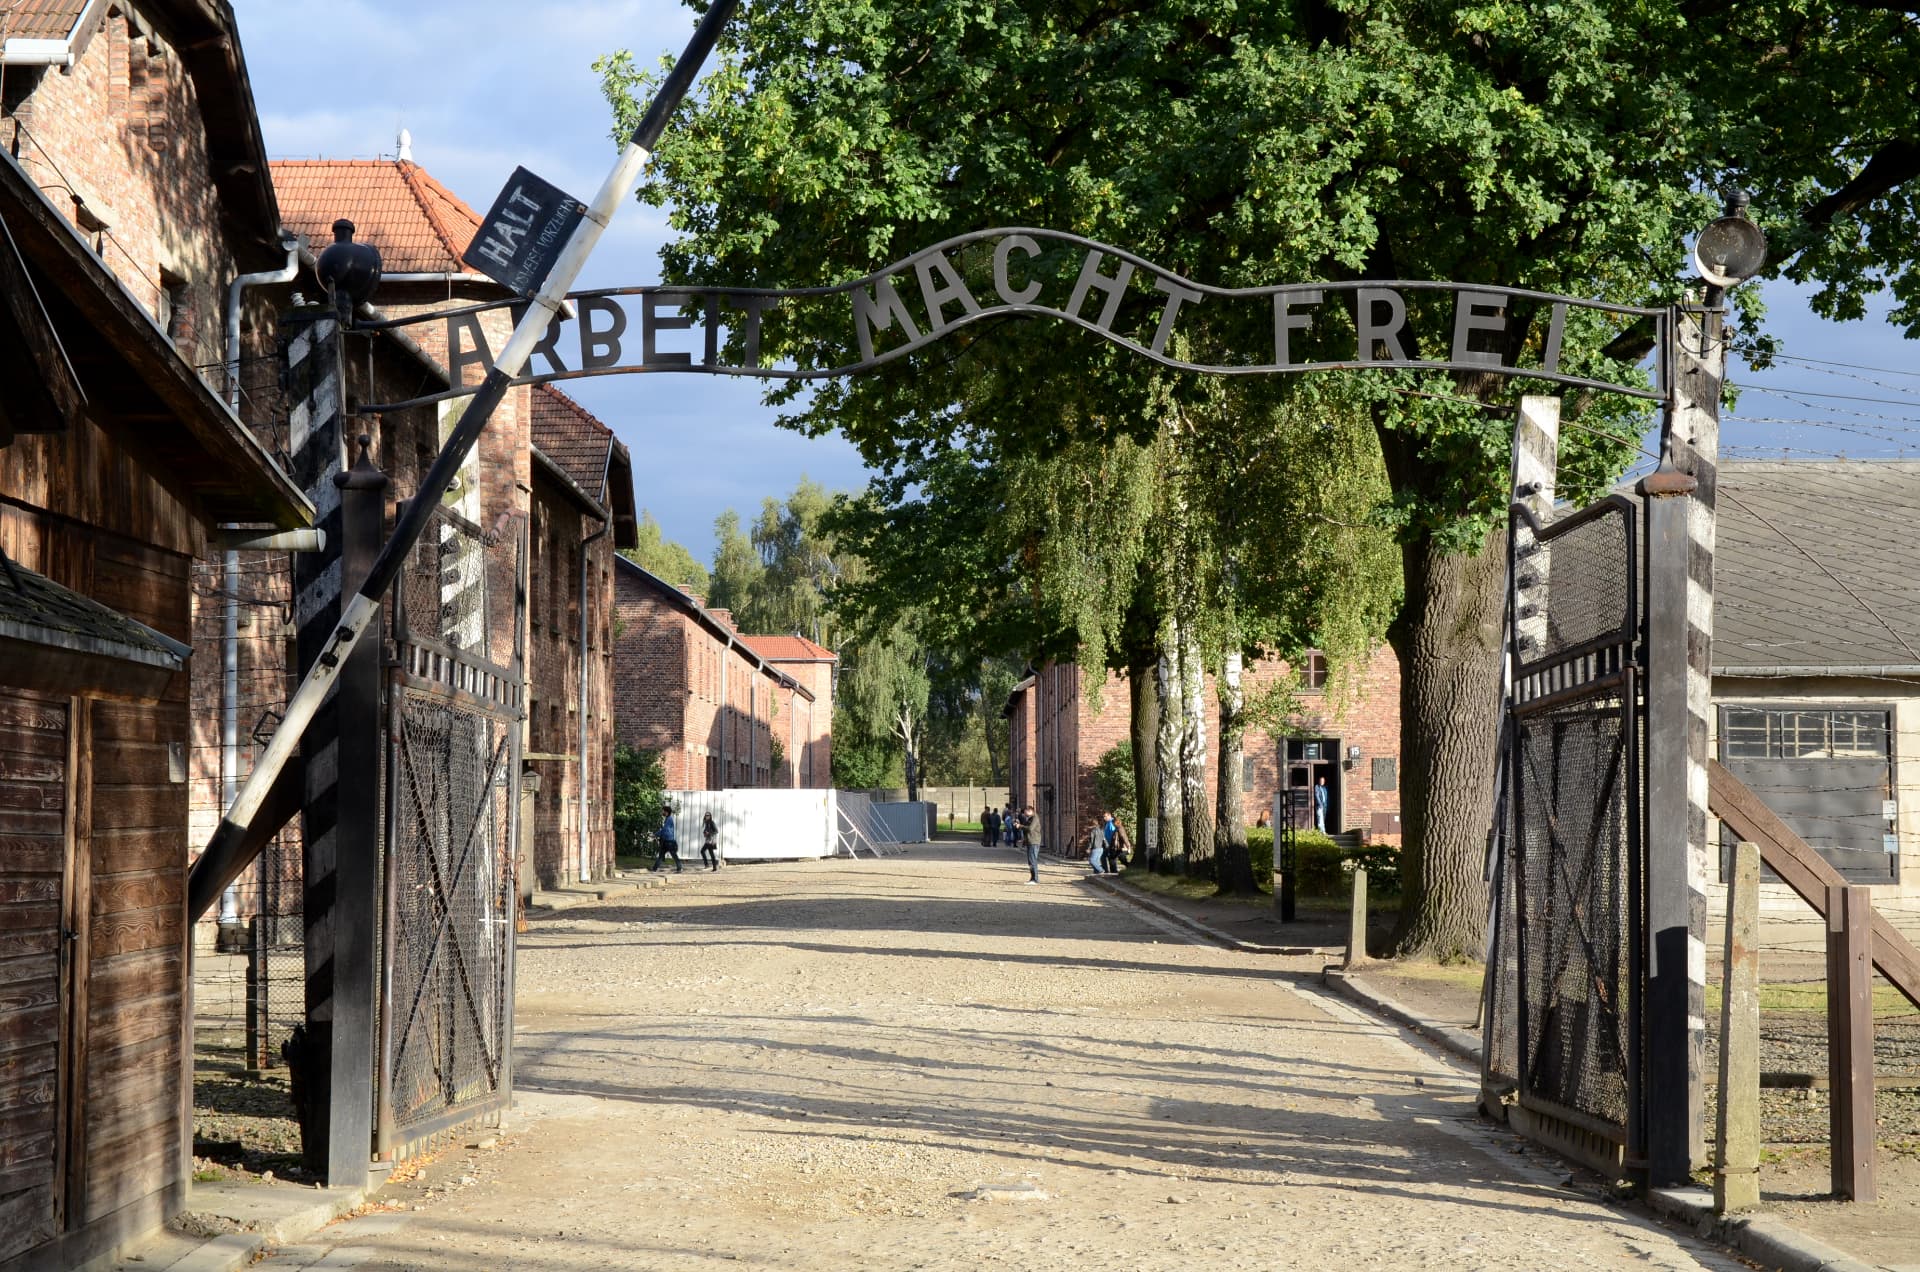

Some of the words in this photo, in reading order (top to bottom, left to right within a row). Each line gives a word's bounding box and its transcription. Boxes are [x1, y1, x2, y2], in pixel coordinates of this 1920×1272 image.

[479, 186, 542, 267] HALT
[448, 293, 777, 388] ARBEIT
[852, 235, 1203, 361] MACHT
[1274, 288, 1567, 373] FREI
